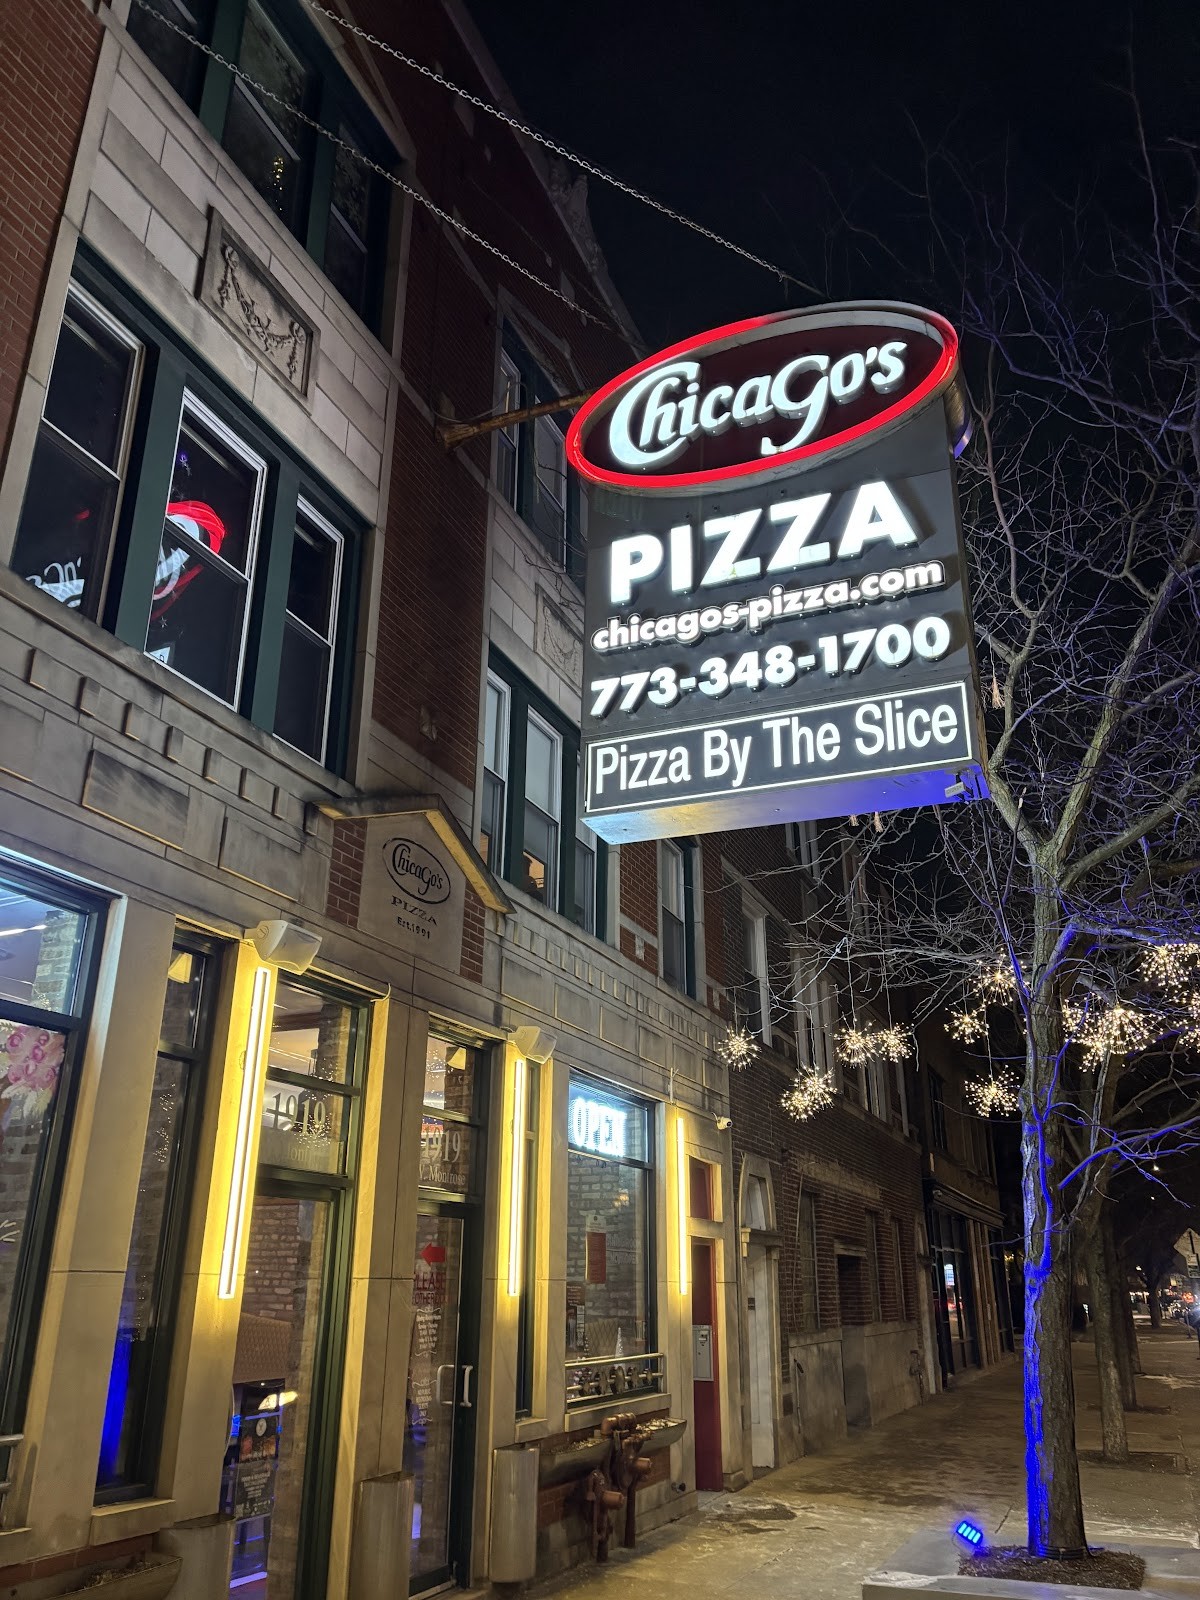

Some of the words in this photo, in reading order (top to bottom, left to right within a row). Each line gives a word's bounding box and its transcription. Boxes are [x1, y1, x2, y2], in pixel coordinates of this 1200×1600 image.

[610, 481, 918, 603] PIZZA
[592, 561, 944, 649] chicagos-pizza.com
[590, 616, 951, 717] 773-348-1700
[595, 744, 691, 794] Pizza
[703, 729, 753, 787] By
[762, 716, 841, 768] The
[854, 699, 959, 756] Slice
[391, 895, 438, 926] PIZZA
[423, 1126, 461, 1163] 1919
[573, 1096, 628, 1157] OPEN
[414, 1271, 446, 1291] LEASE
